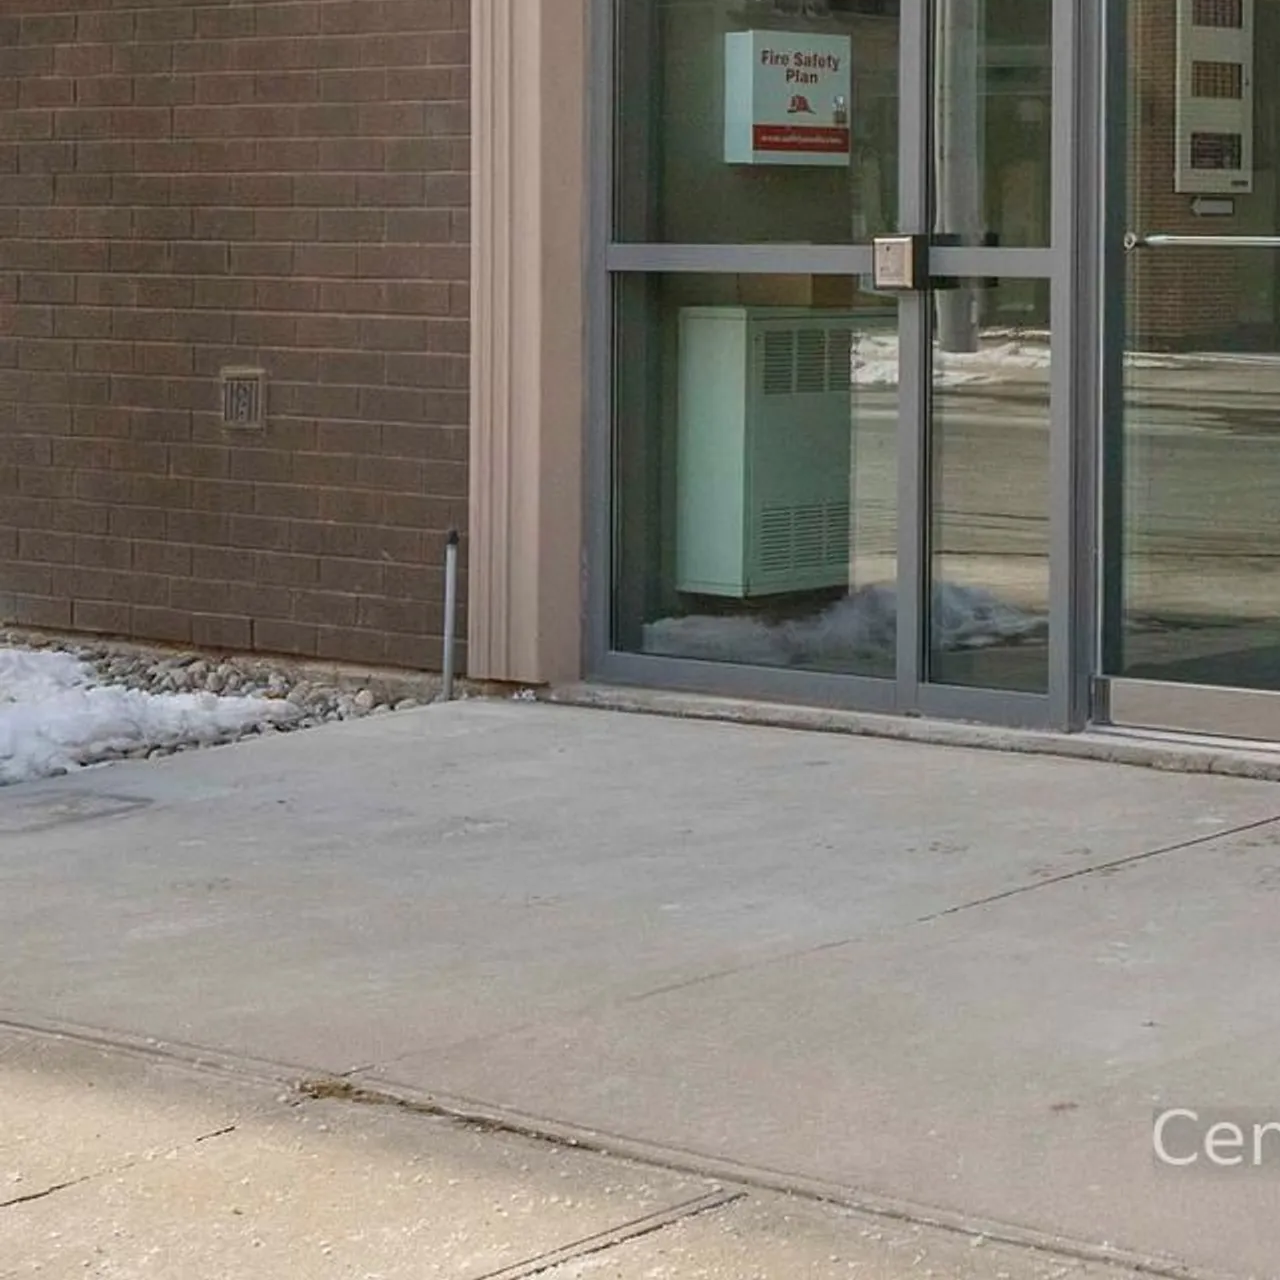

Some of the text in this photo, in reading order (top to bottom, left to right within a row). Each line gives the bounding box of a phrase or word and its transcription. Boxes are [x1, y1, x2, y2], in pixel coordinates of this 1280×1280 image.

[760, 49, 841, 72] Fire Safety
[785, 69, 819, 84] Plan
